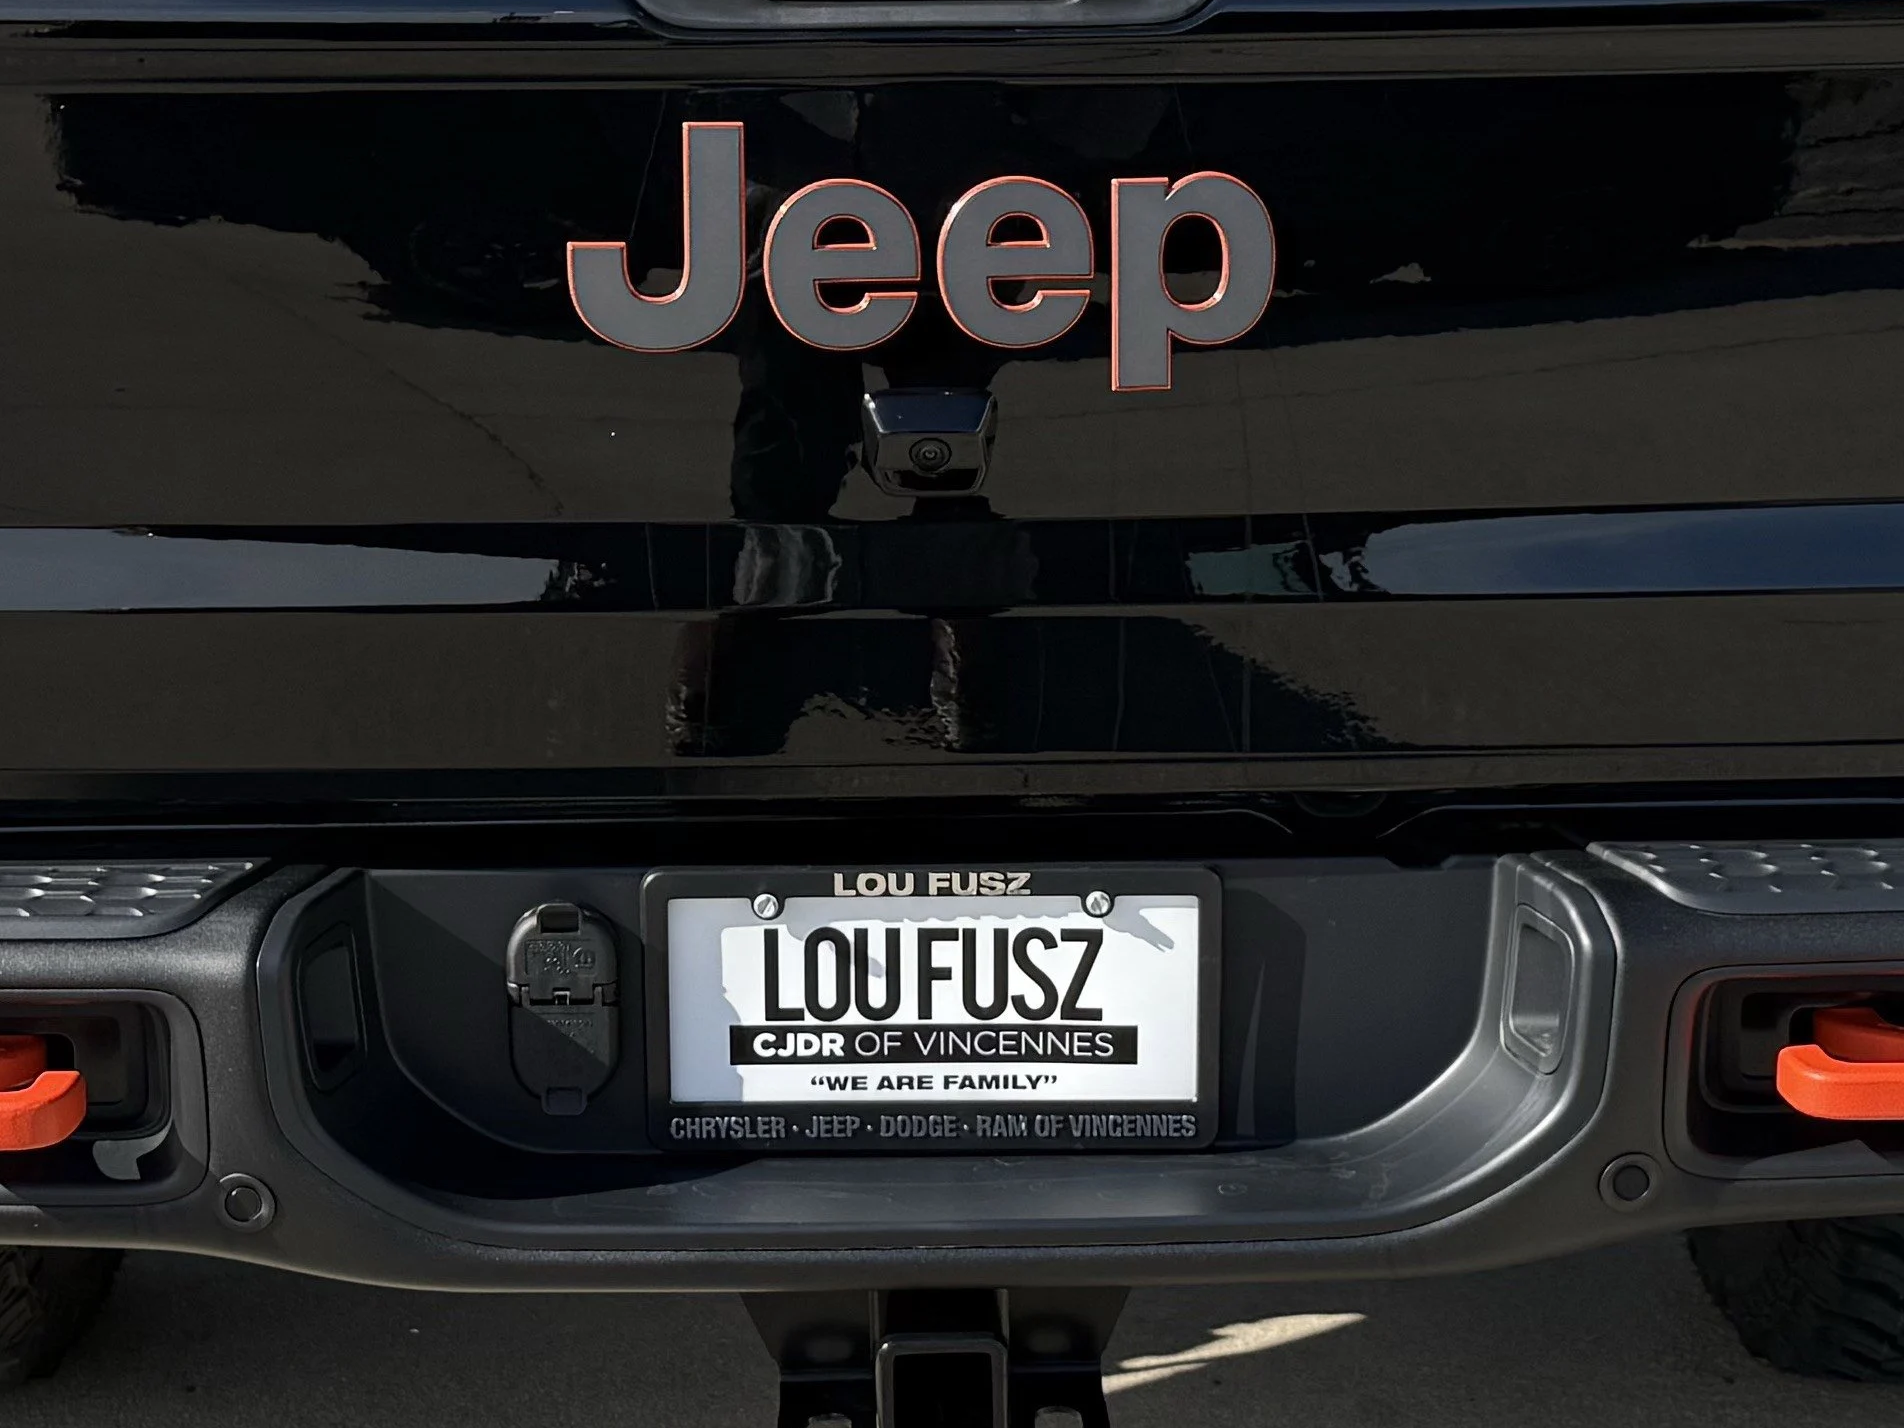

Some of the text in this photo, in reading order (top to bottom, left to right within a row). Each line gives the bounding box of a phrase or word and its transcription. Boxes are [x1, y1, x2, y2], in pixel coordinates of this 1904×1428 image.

[566, 121, 1276, 393] Jeep
[834, 872, 1032, 897] LOU FUSZ
[752, 1030, 1114, 1058] CJDR OF VINCENNES
[876, 1075, 934, 1091] ARE
[670, 1114, 1197, 1139] CHRYSLER JEEP DODGE RAM OF VINCENNES
